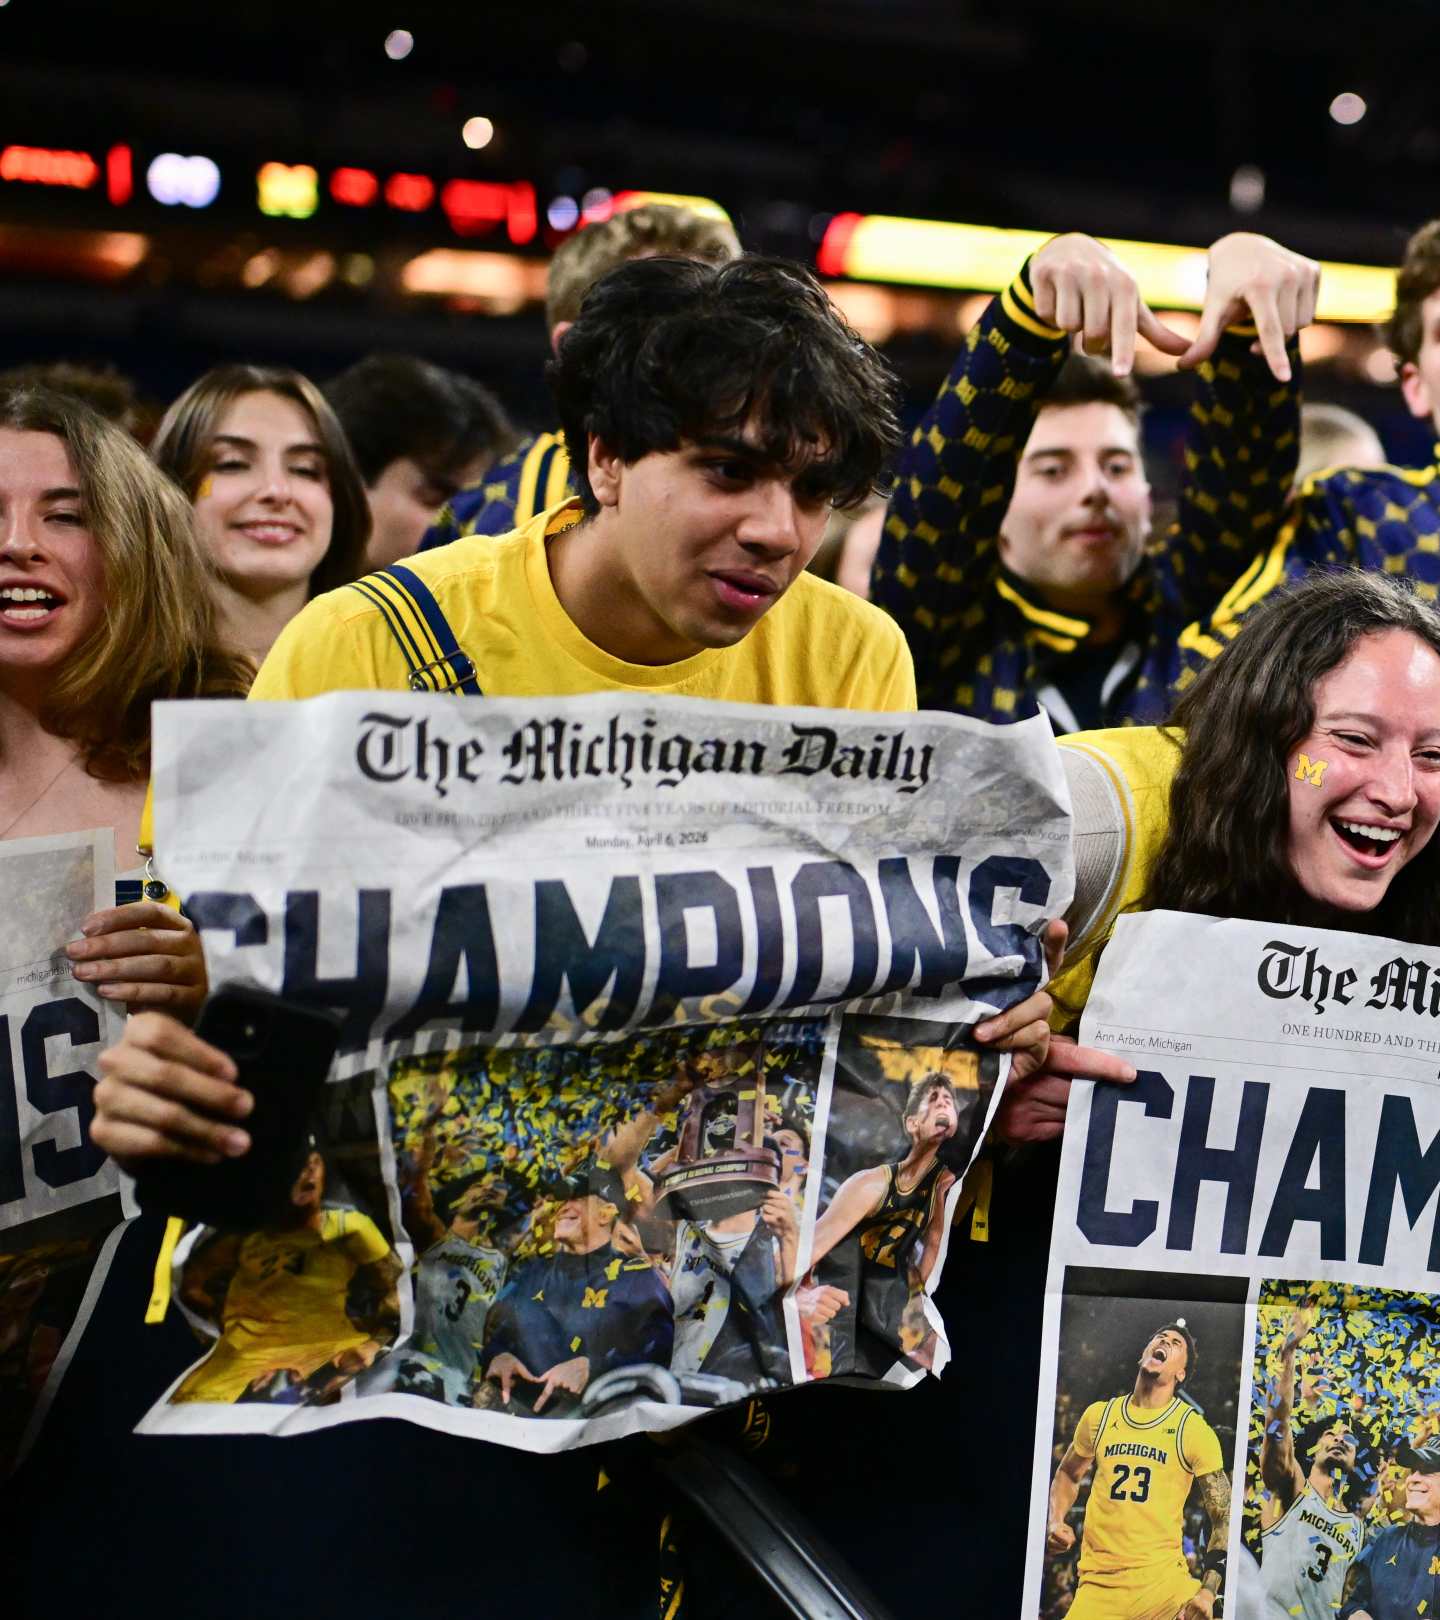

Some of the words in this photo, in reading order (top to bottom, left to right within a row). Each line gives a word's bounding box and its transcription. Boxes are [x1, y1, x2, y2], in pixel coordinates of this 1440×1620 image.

[357, 712, 484, 797] The
[502, 714, 767, 790] Michigan
[782, 724, 935, 794] Daily
[1295, 752, 1328, 788] M
[817, 802, 891, 817] FREEDOM
[679, 831, 708, 845] 2026
[1257, 940, 1359, 1015] The
[1095, 1030, 1115, 1042] Ann
[1118, 1033, 1146, 1047] Arbor,
[1149, 1037, 1193, 1052] Michigan
[1282, 1023, 1310, 1037] ONE
[1313, 1026, 1382, 1044] HUNDRED
[1384, 1035, 1414, 1049] AND
[445, 1279, 471, 1321] 3
[581, 1286, 609, 1309] M
[1104, 1443, 1168, 1465] MICHIGAN
[1110, 1464, 1151, 1503] 23
[1307, 1543, 1333, 1583] 3
